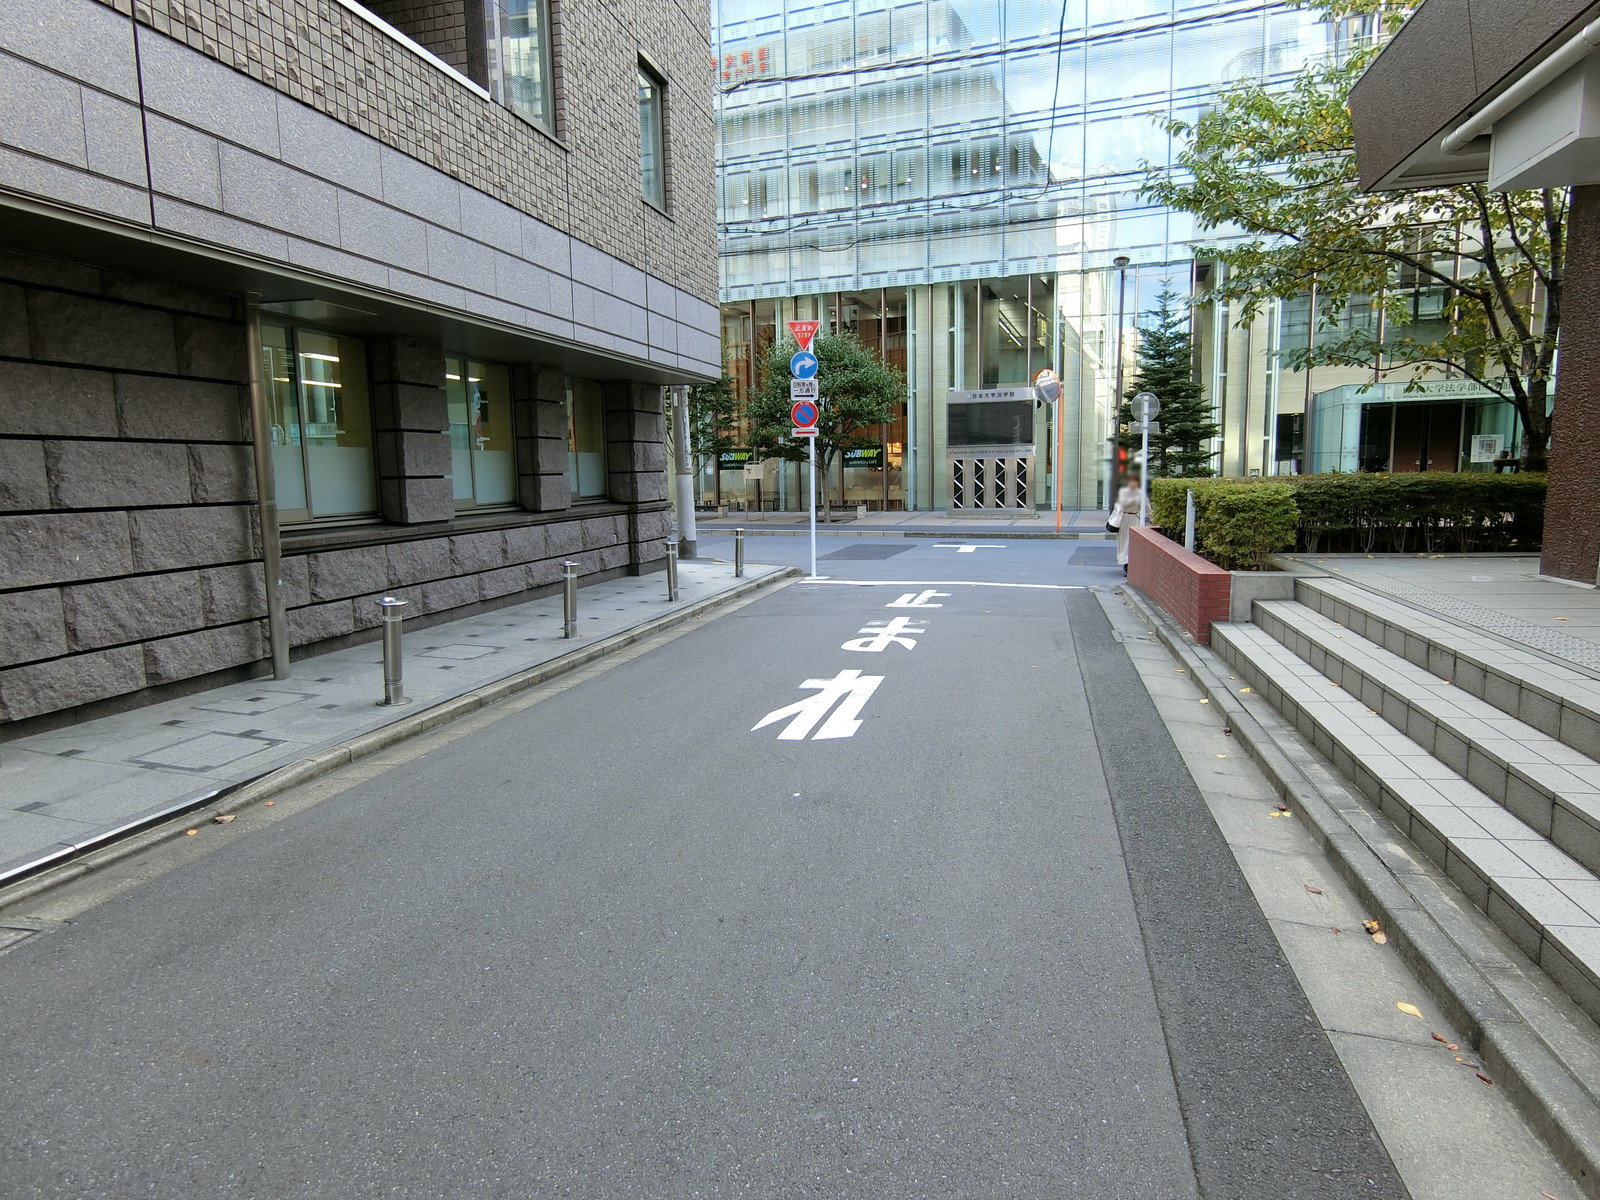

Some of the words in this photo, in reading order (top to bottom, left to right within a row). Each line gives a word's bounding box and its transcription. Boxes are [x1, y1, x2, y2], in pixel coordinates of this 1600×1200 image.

[794, 324, 814, 332] 止まれ
[972, 391, 1015, 399] 日本大学法学部
[720, 452, 752, 460] SUBWAY
[844, 449, 881, 458] SUBWAY
[750, 590, 952, 740] 止まれ
